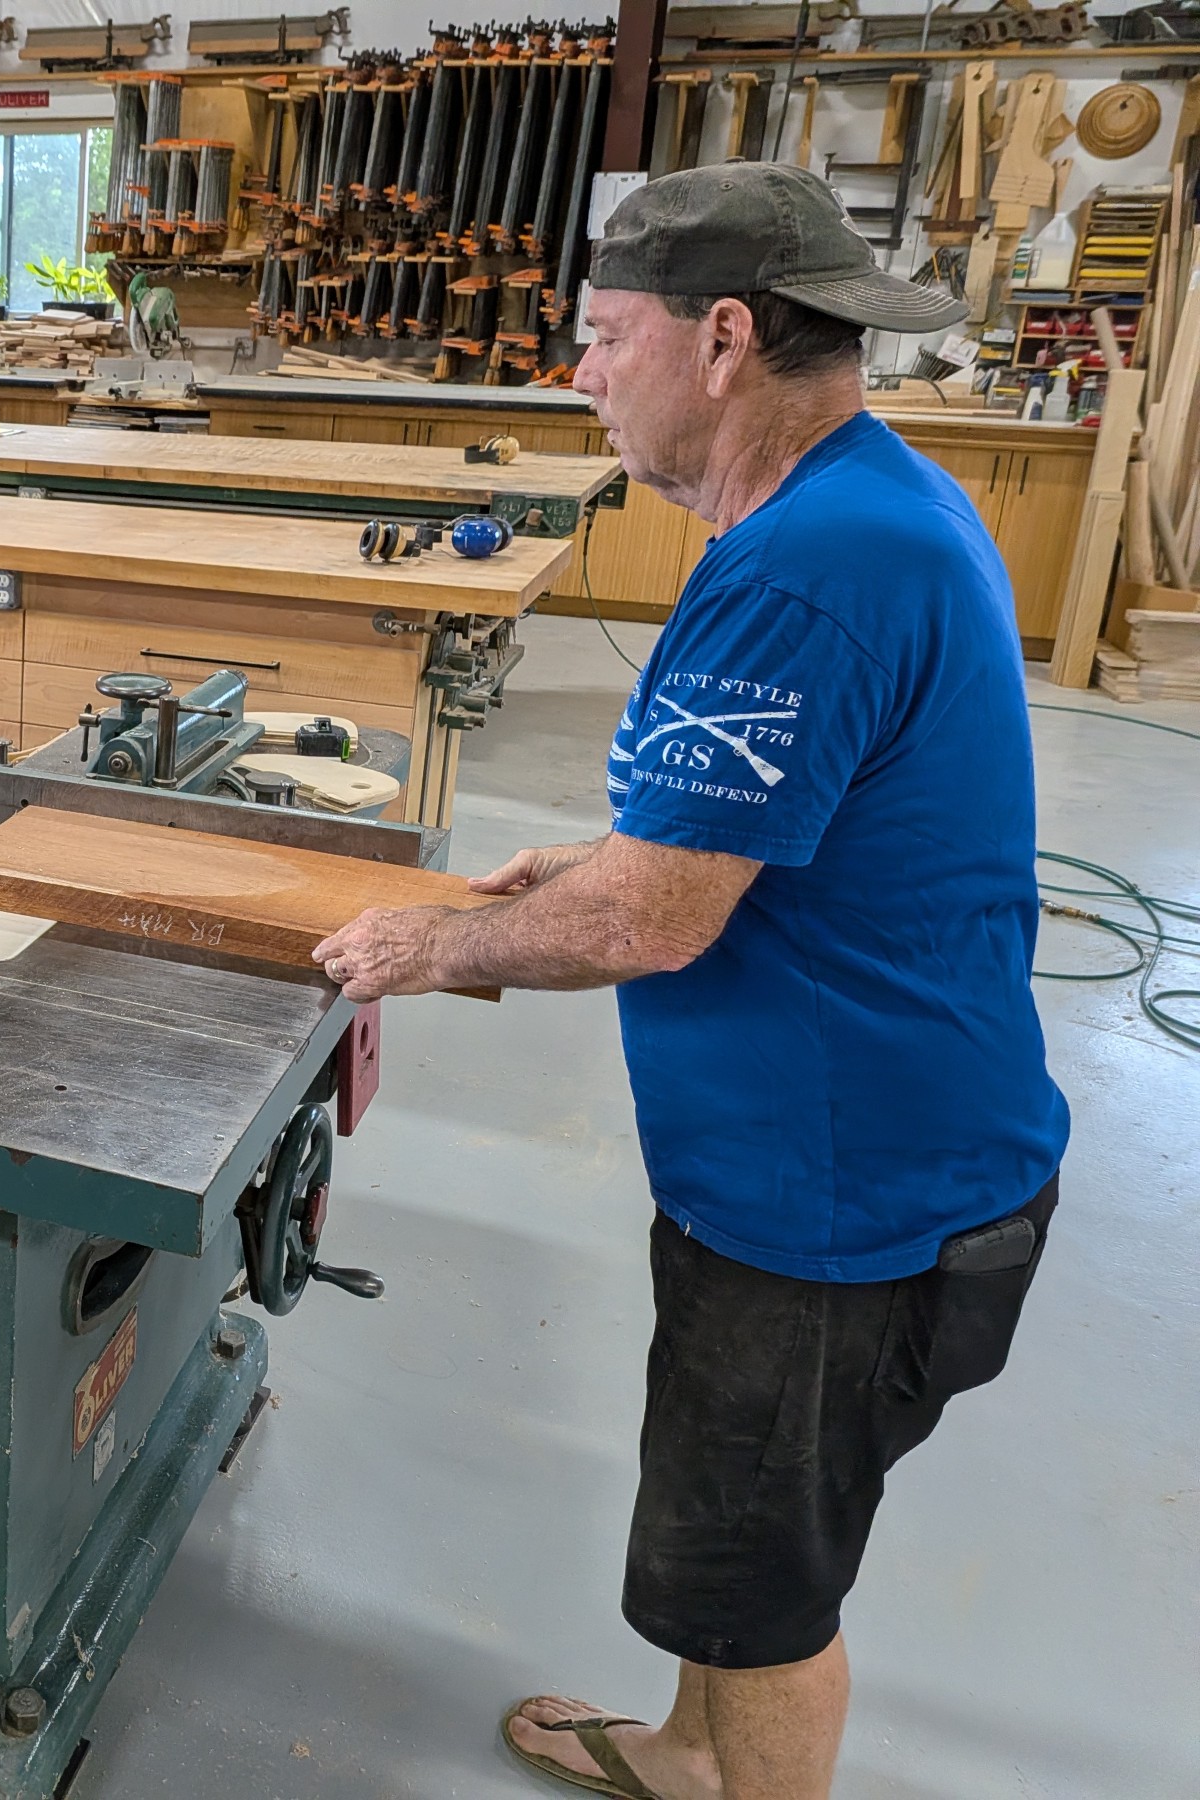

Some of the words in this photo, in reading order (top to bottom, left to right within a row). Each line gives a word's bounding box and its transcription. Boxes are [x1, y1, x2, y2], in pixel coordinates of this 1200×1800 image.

[0, 92, 48, 106] OLIVER
[718, 677, 803, 708] STYLE
[739, 723, 795, 747] 1776
[662, 739, 715, 771] GS
[645, 770, 687, 790] WE'LL
[689, 780, 768, 804] DEFEND
